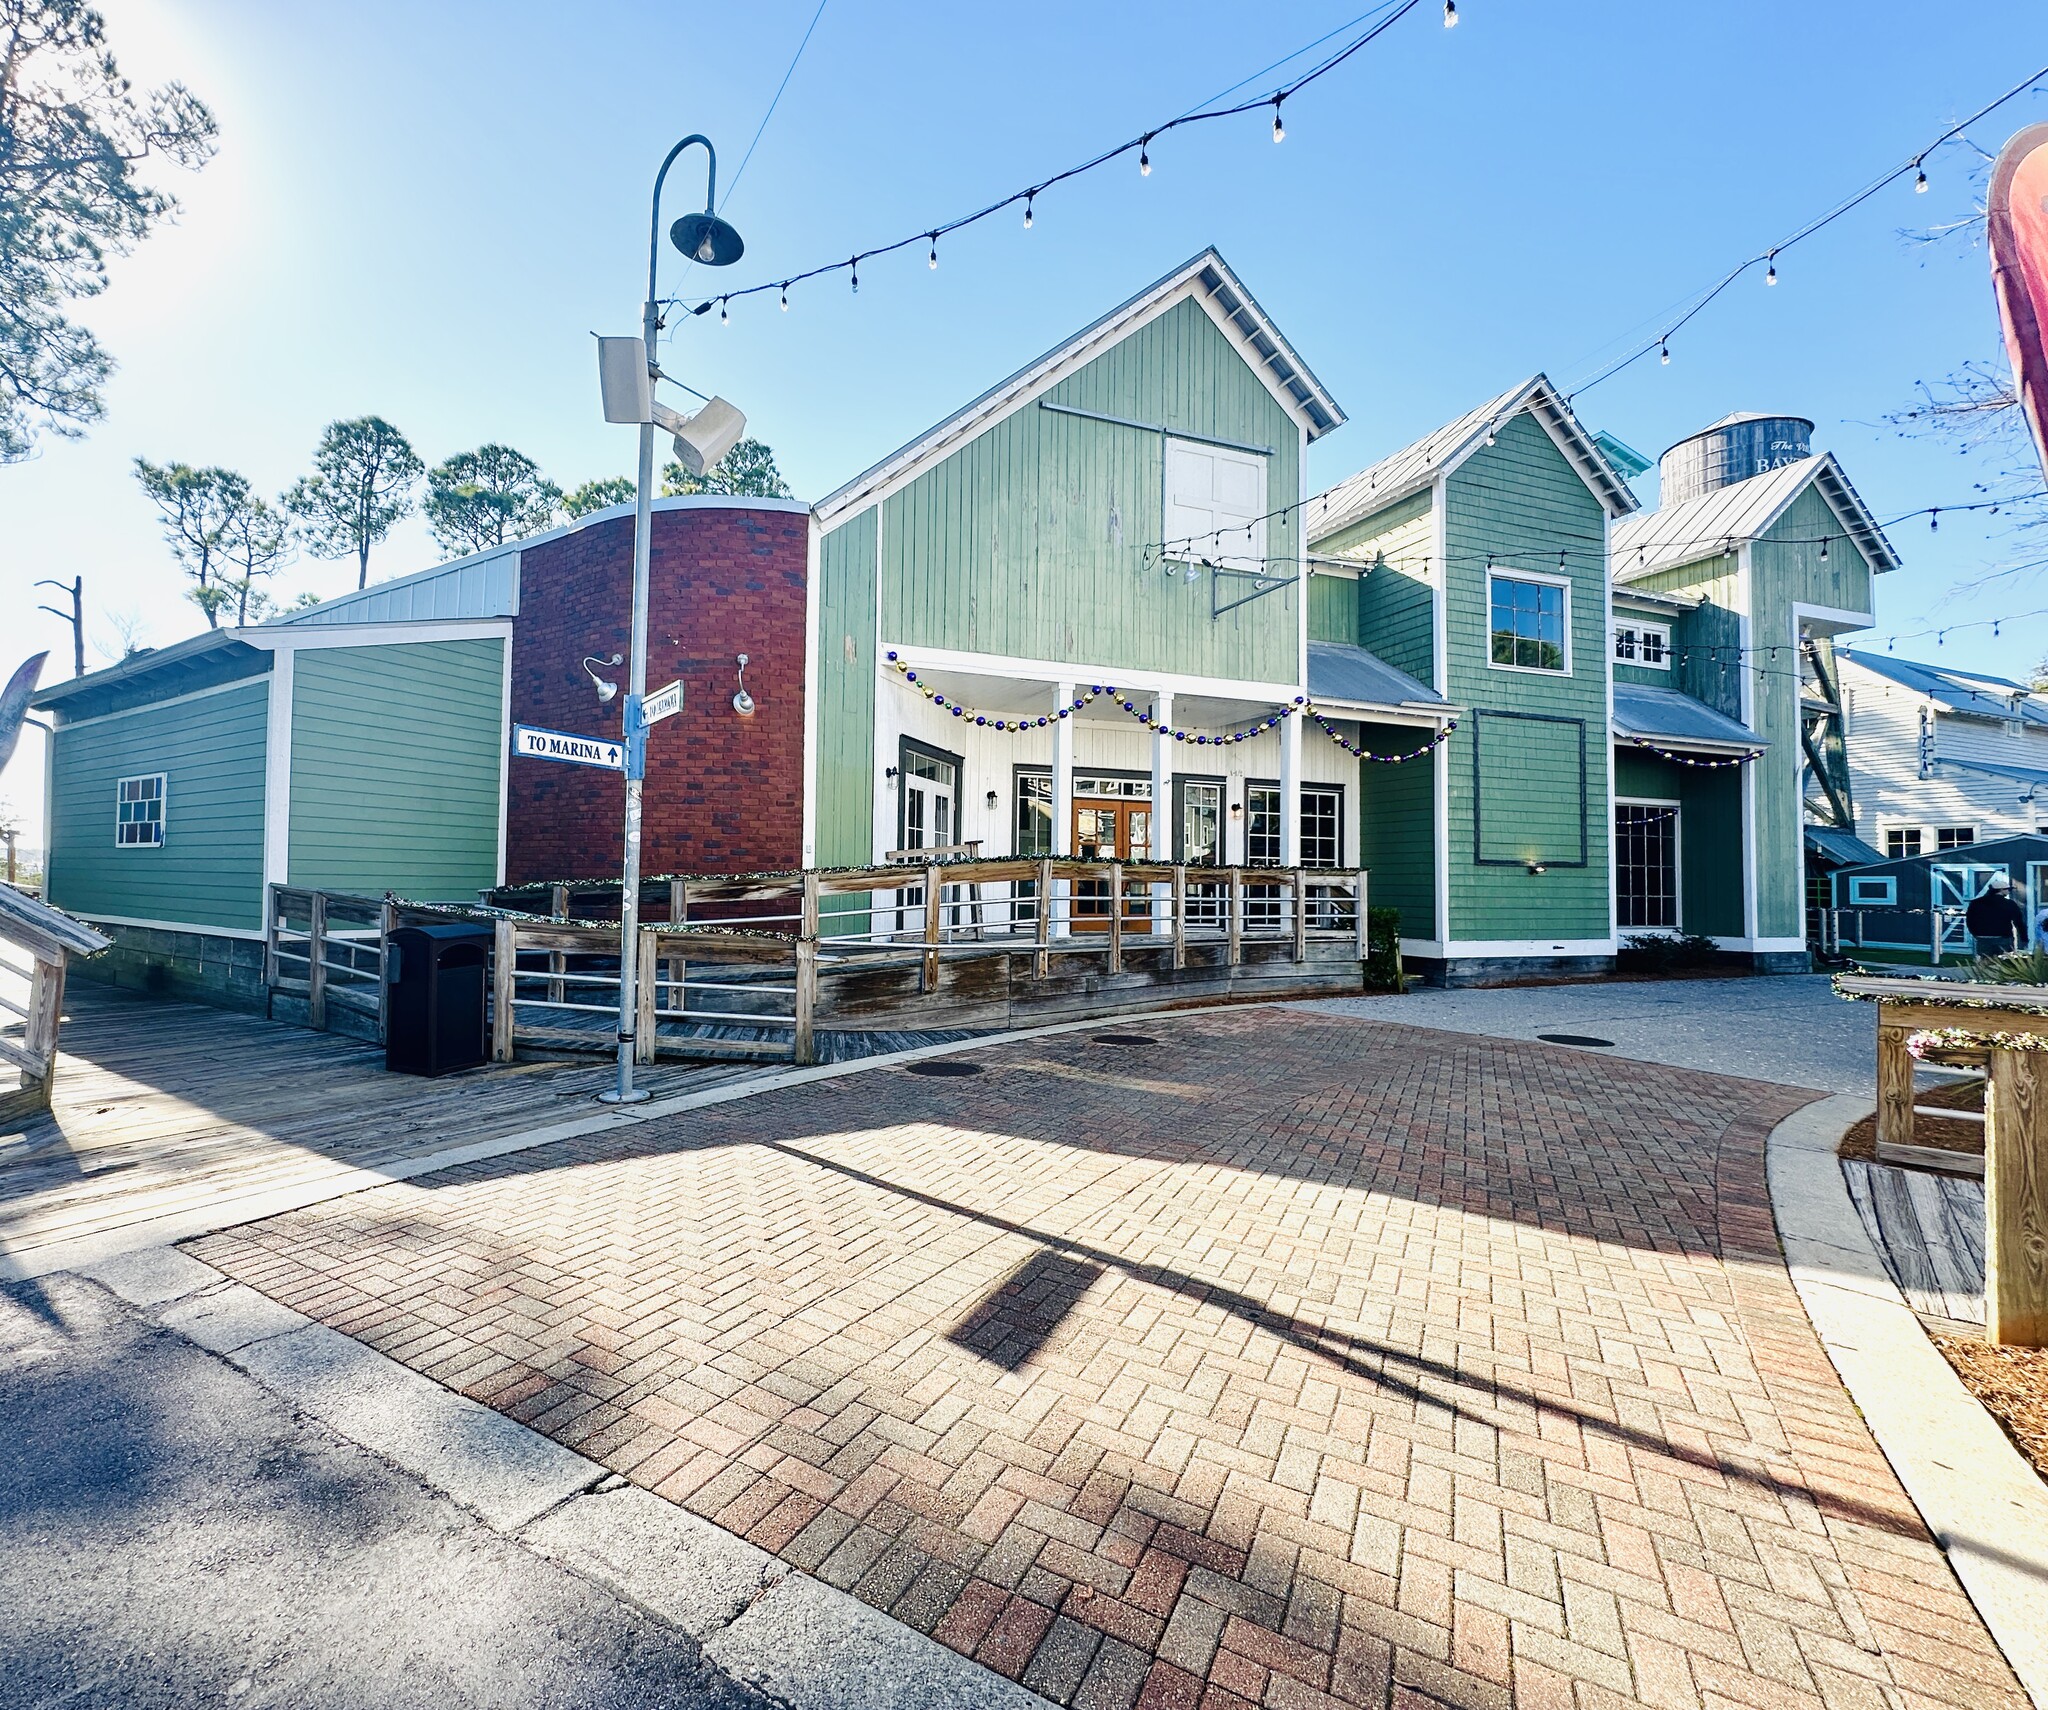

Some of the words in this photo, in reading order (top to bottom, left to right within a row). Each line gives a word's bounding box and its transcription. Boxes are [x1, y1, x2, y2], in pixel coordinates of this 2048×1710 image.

[1770, 440, 1793, 451] The
[527, 735, 546, 752] TO
[549, 739, 602, 761] MARINA
